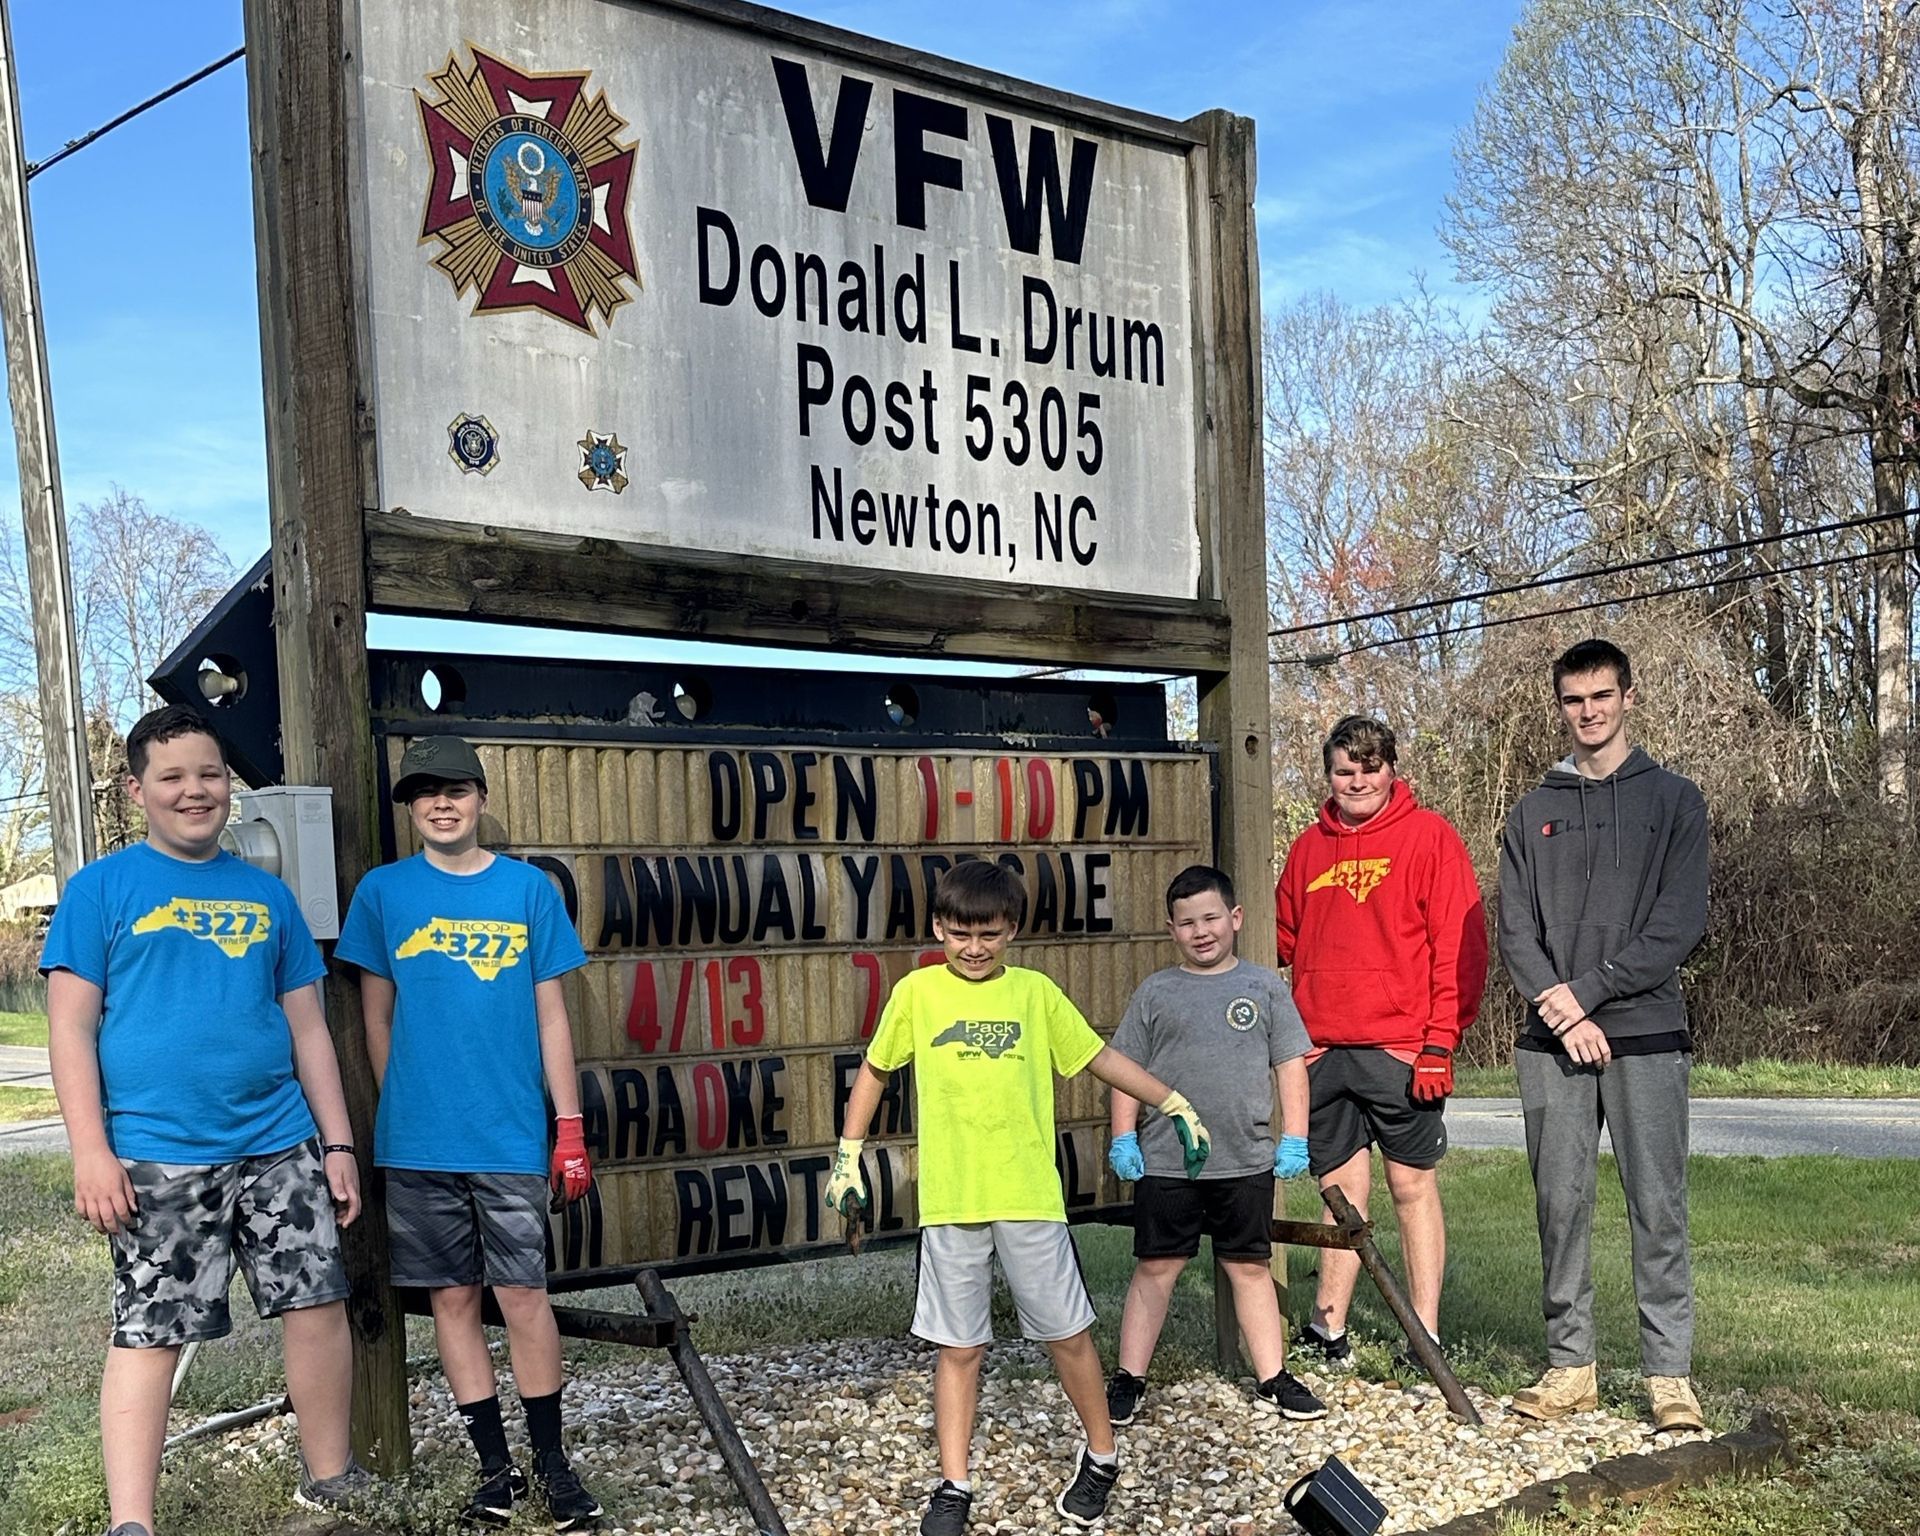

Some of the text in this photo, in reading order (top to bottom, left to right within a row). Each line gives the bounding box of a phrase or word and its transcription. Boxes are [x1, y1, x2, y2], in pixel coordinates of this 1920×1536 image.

[471, 119, 590, 200] VETERANS OF FOREIGN WARS
[771, 56, 1098, 265] VFW
[475, 199, 588, 265] OF THE UNITED STATES
[696, 205, 1164, 387] Donald L. Drum
[797, 342, 1103, 476] Post 5305
[810, 464, 1098, 573] Newton, NC
[709, 750, 877, 842] OPEN
[1073, 758, 1151, 839] PM
[193, 902, 253, 911] TROOP
[598, 854, 826, 947] ANNUAL
[841, 853, 978, 939] YA
[1339, 870, 1375, 889] 327
[192, 912, 258, 936] 327
[447, 933, 511, 958] 327
[449, 922, 510, 932] TROOP
[627, 955, 764, 1052] 4/13
[965, 1021, 1014, 1034] Pack
[972, 1033, 1009, 1047] 327
[573, 1057, 788, 1159] ARAOKE
